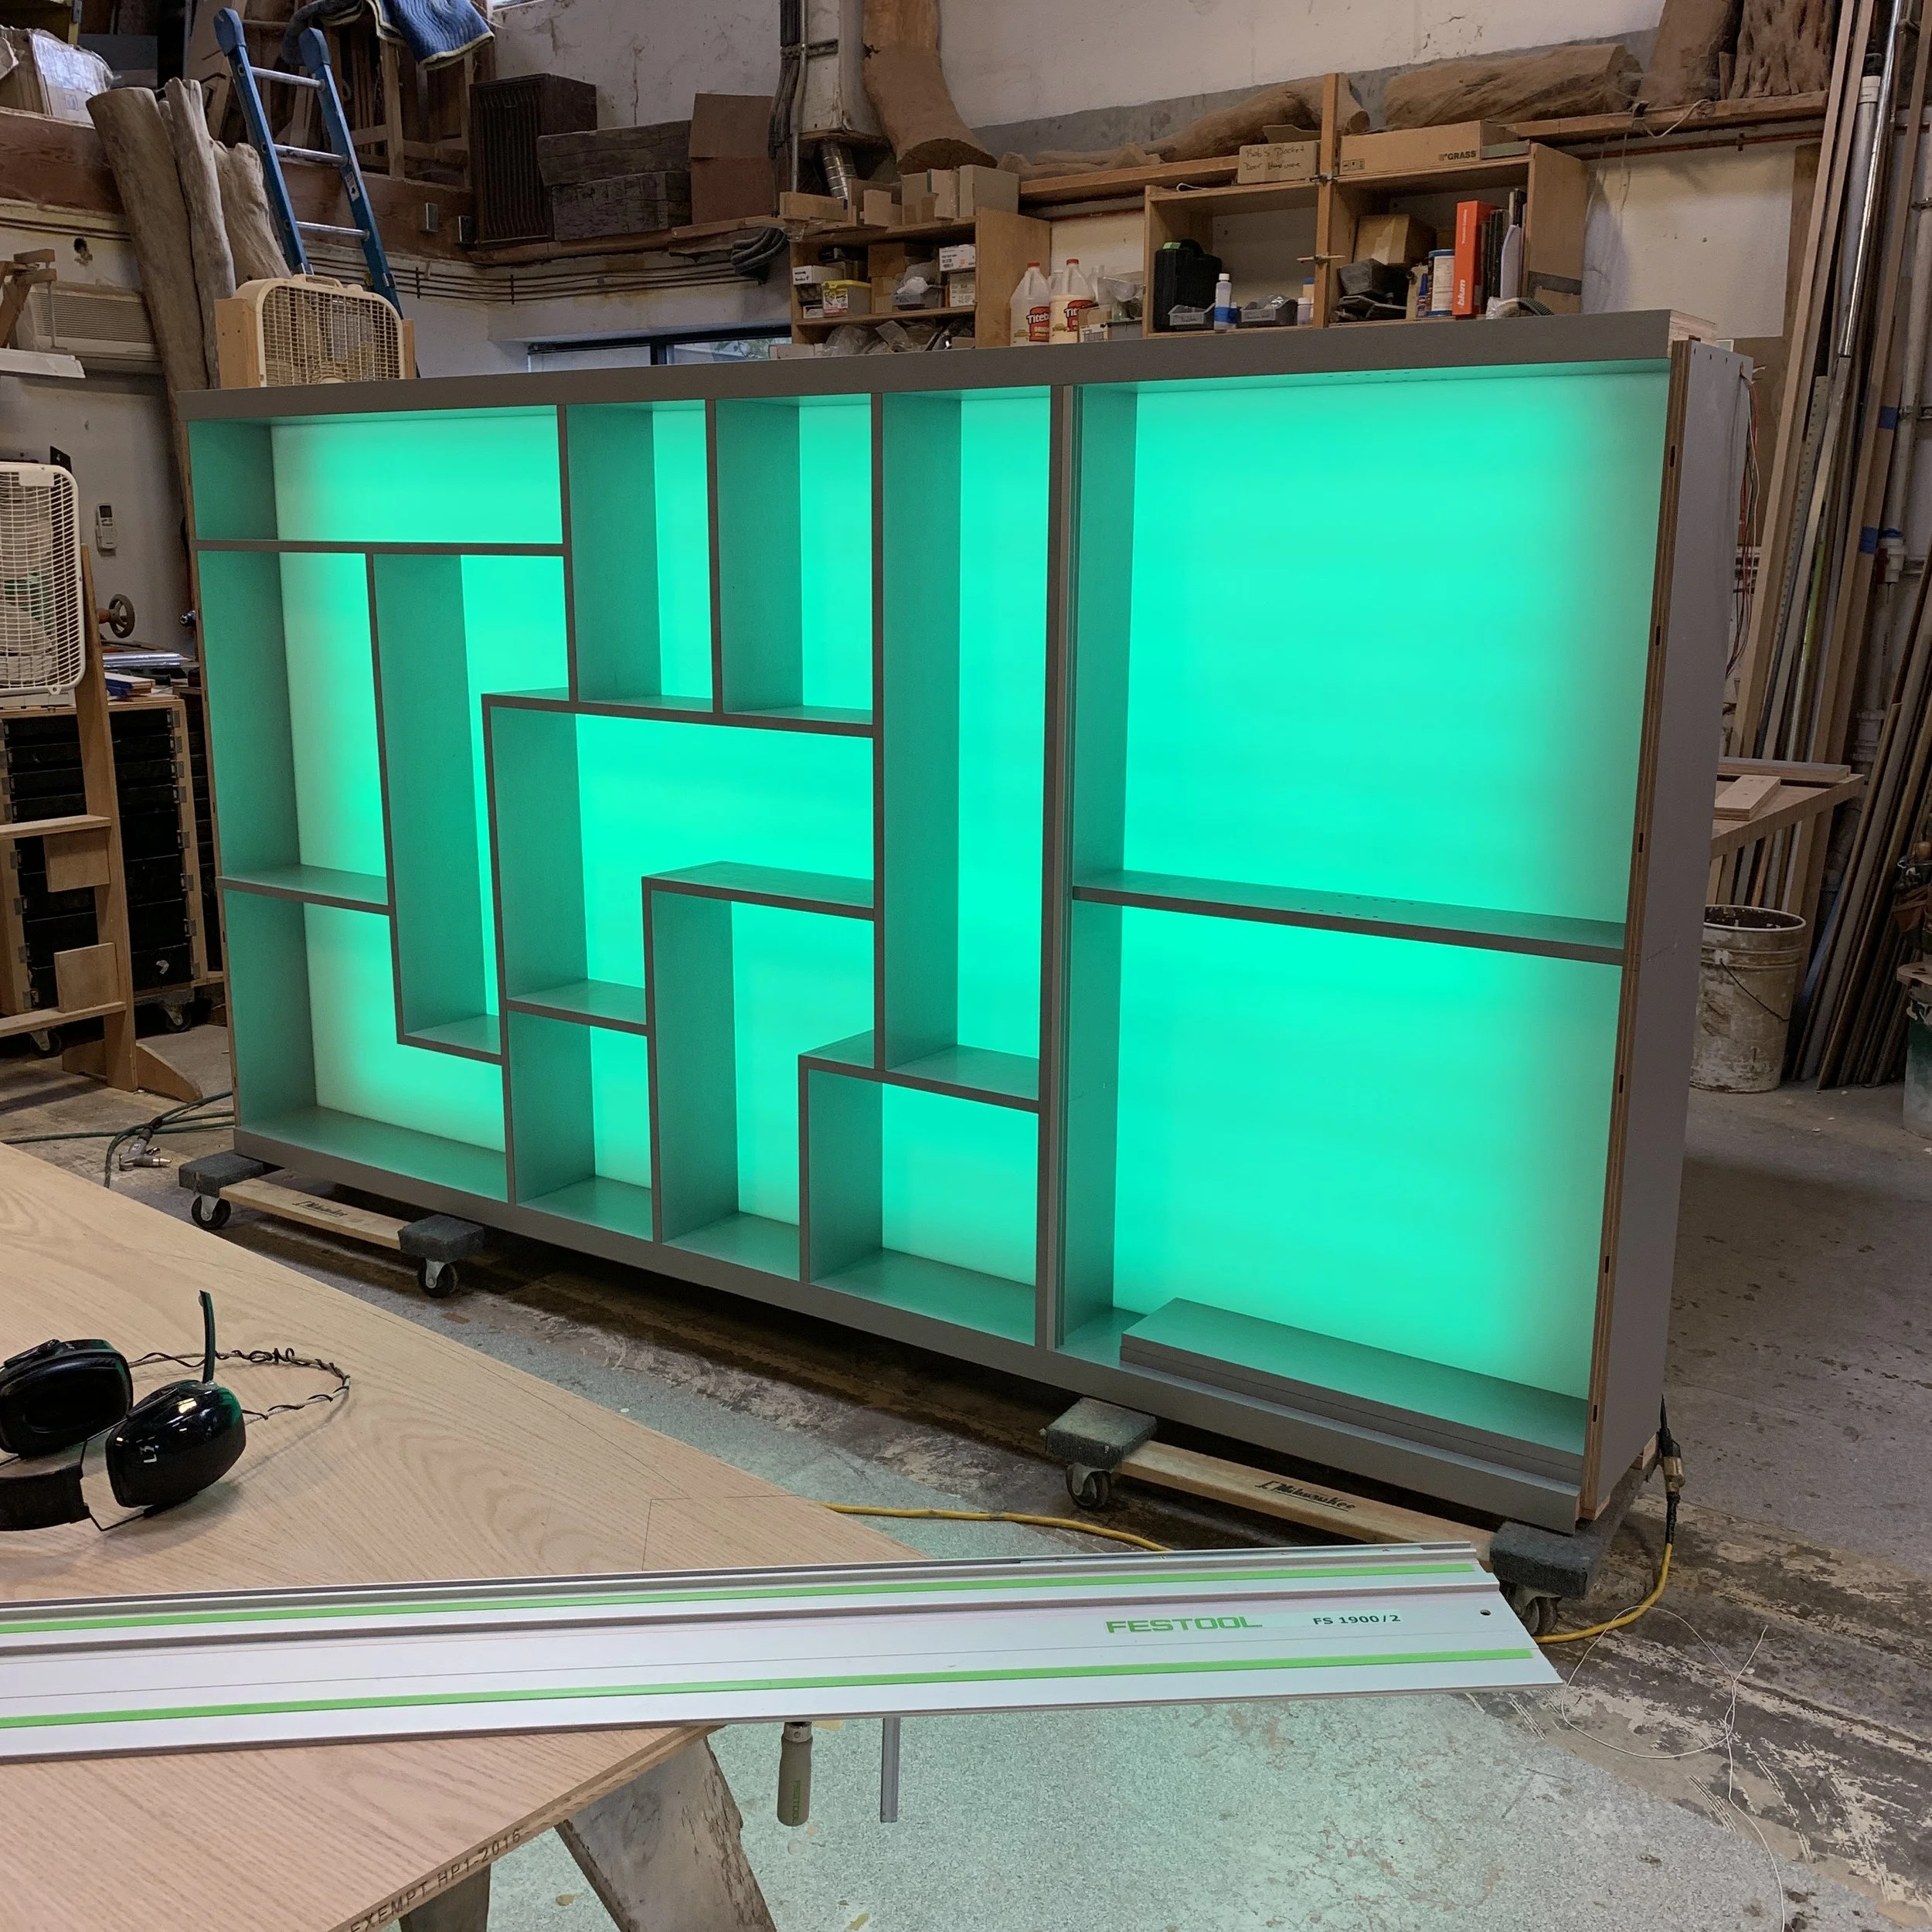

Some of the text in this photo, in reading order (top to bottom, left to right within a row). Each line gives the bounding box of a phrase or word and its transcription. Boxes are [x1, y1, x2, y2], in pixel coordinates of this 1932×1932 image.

[1447, 150, 1477, 160] GRASS
[1458, 279, 1466, 307] blum
[1270, 1482, 1356, 1510] Milwaukee
[1106, 1616, 1263, 1633] FESTOOL
